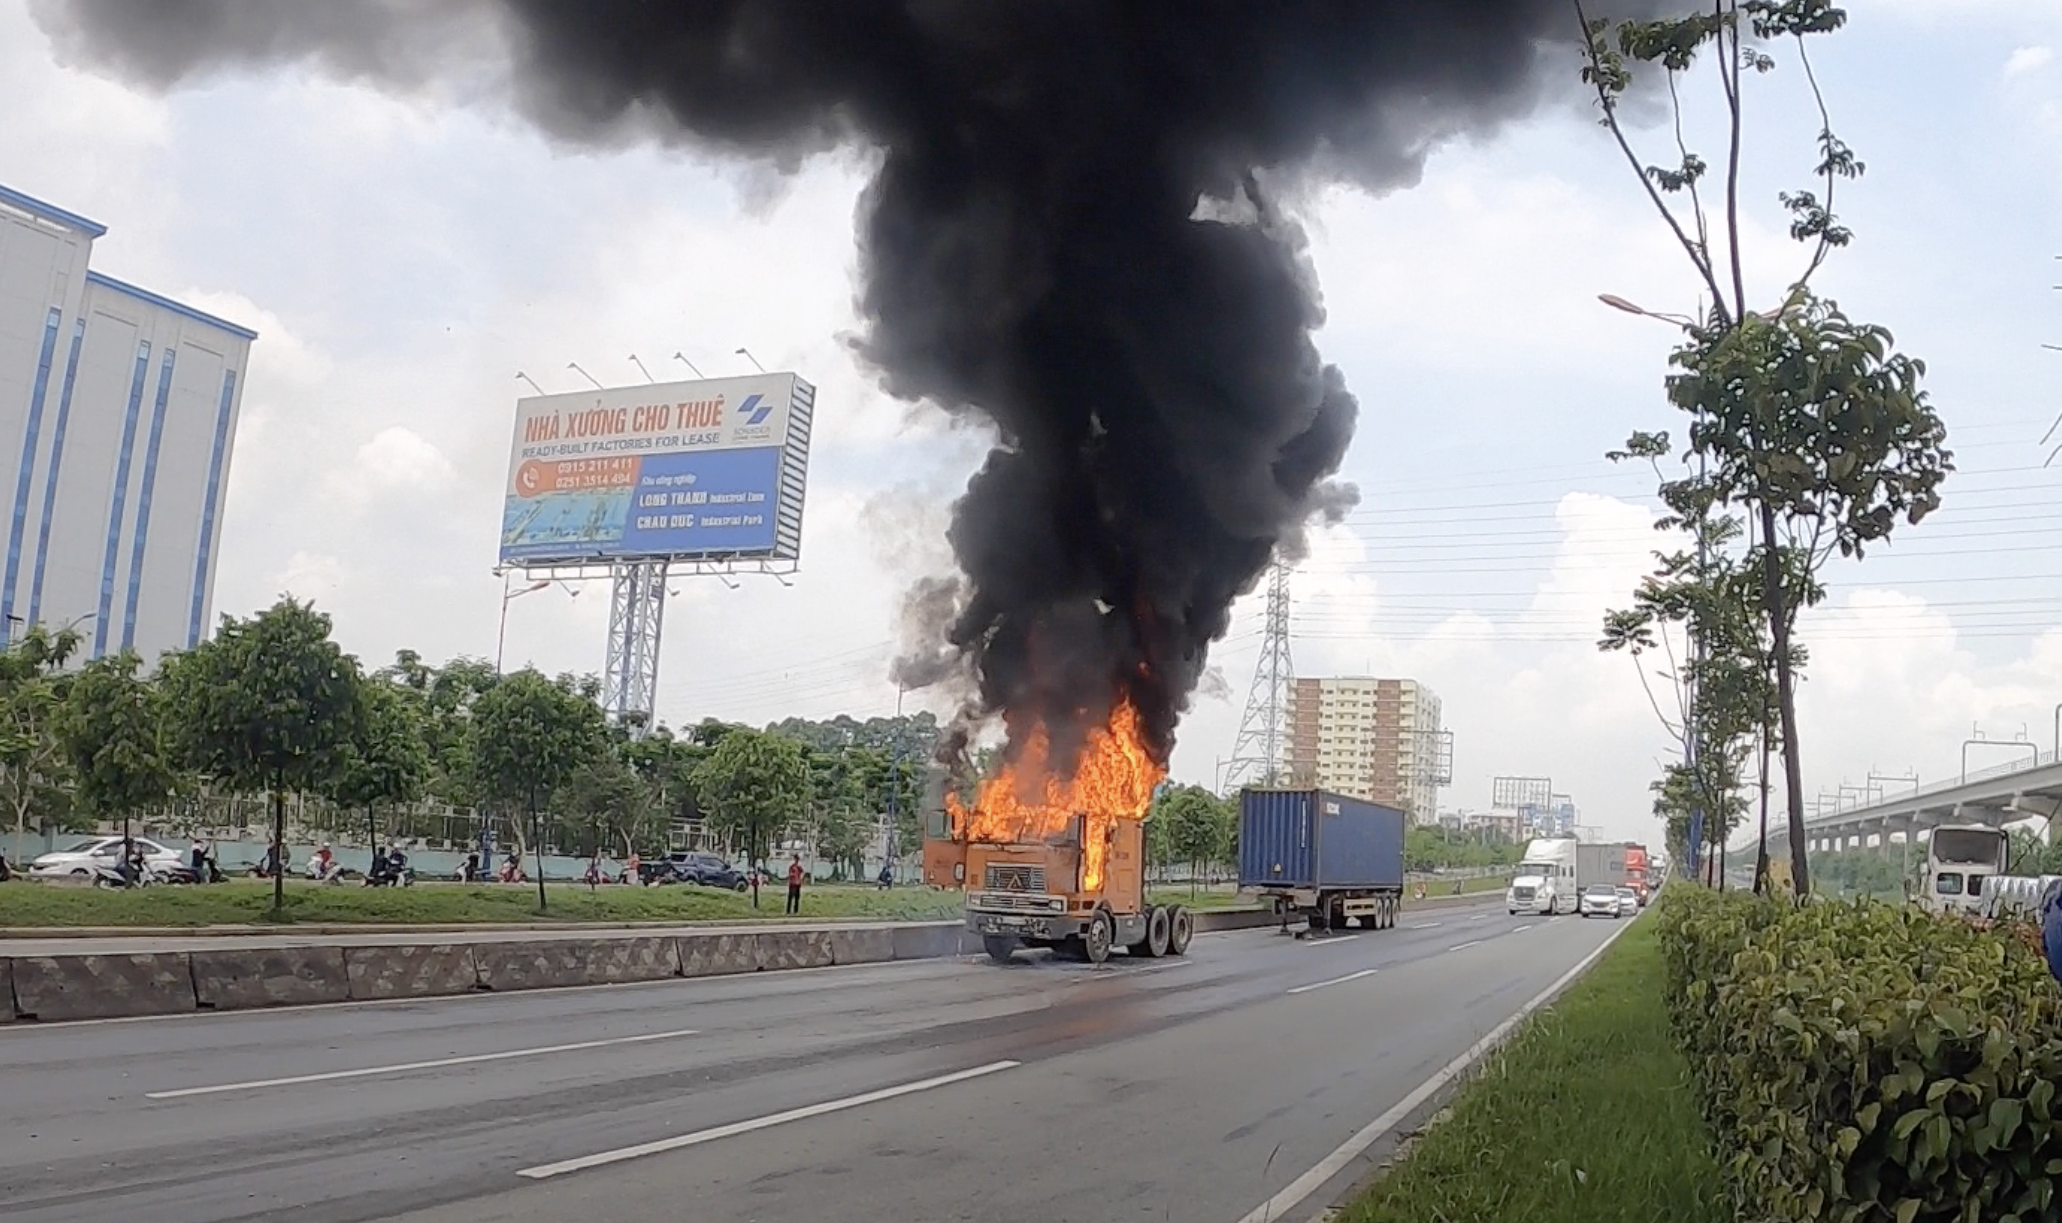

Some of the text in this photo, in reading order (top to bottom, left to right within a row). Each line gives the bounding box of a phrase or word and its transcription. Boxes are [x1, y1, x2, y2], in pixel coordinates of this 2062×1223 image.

[632, 404, 670, 433] CHO
[677, 393, 725, 429] THUÊ
[522, 432, 721, 458] READY-BUILT FACTORIES FOR LEASE
[588, 459, 608, 472] 211
[612, 457, 632, 470] 411
[639, 492, 667, 507] LONG
